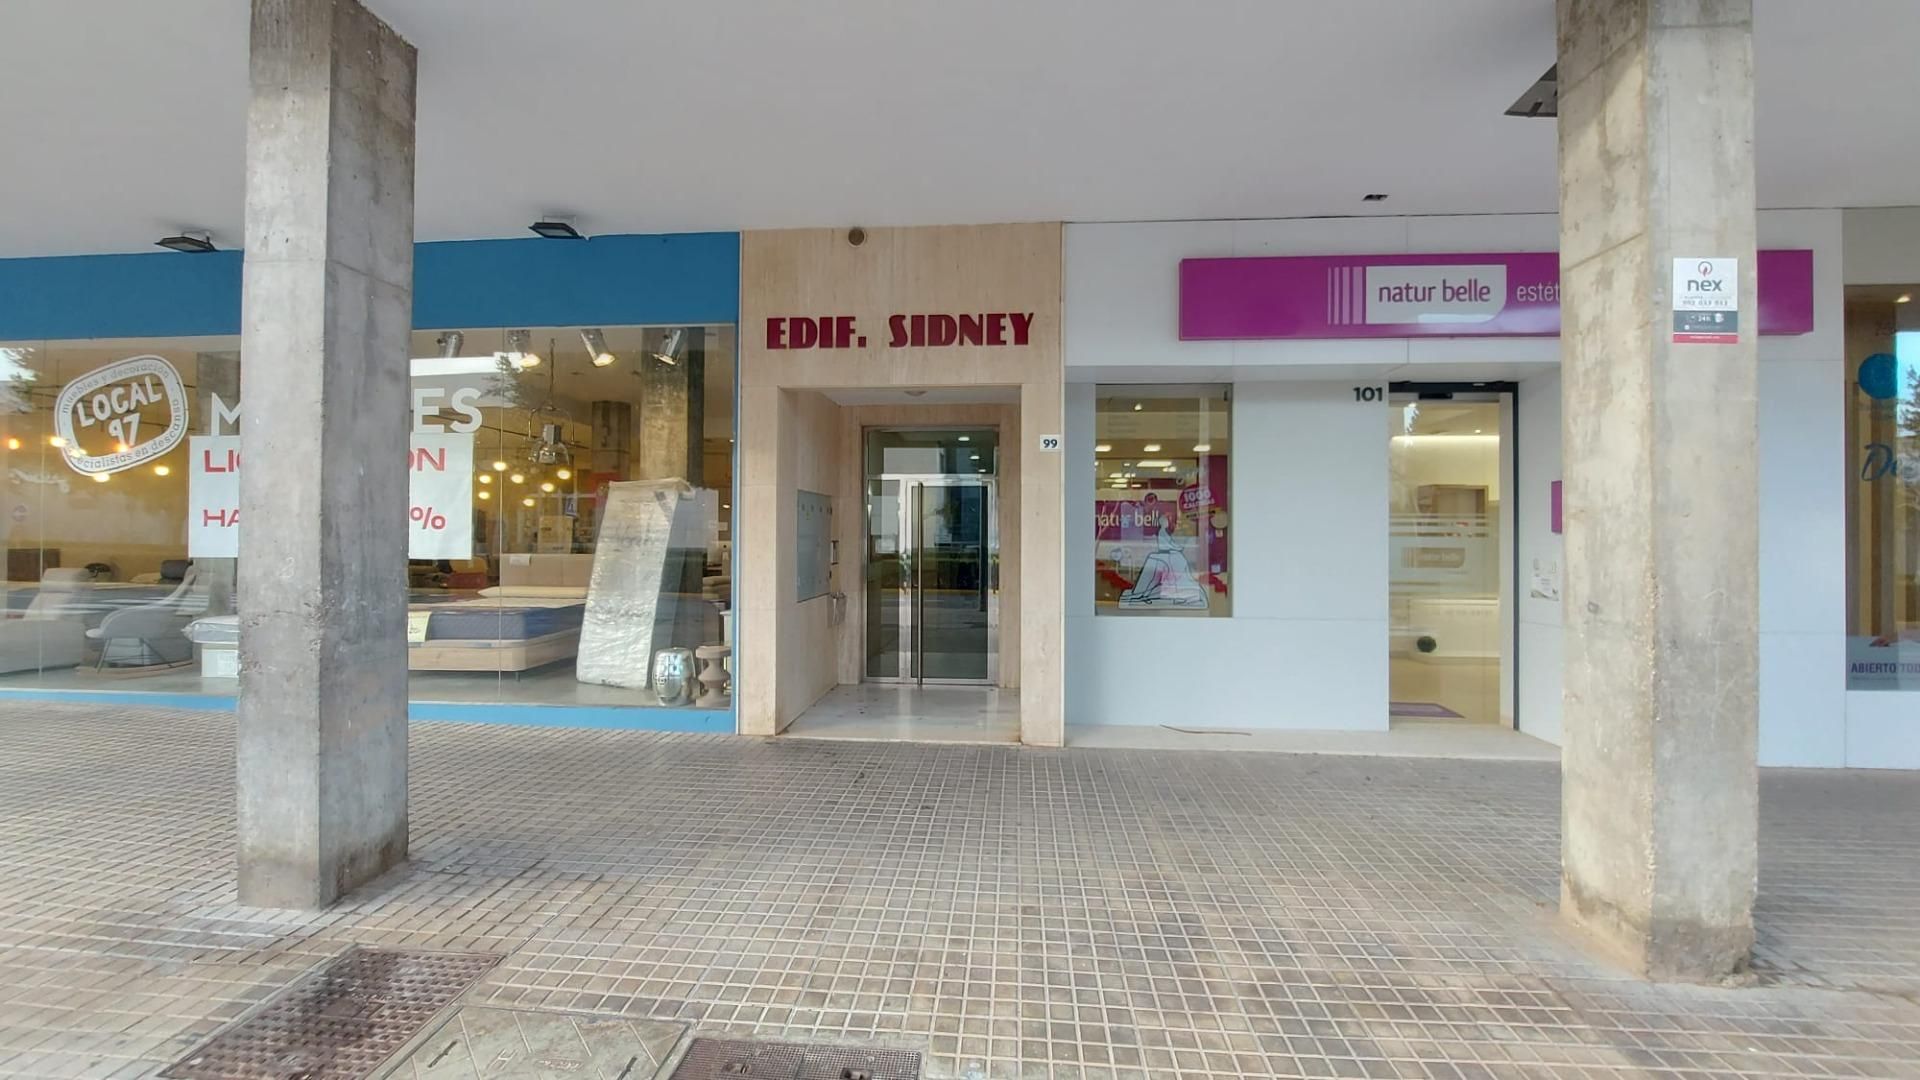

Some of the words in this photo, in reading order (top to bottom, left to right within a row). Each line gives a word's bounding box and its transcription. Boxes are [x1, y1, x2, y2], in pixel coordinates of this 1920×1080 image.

[1378, 283, 1436, 302] natur
[1443, 278, 1490, 302] belle
[1687, 279, 1722, 292] nex
[766, 316, 867, 349] EDIF.
[889, 313, 1034, 347] SIDNEY
[77, 376, 162, 427] LOCAL
[1353, 387, 1383, 402] 101
[109, 412, 141, 449] 97
[1043, 438, 1058, 449] 99
